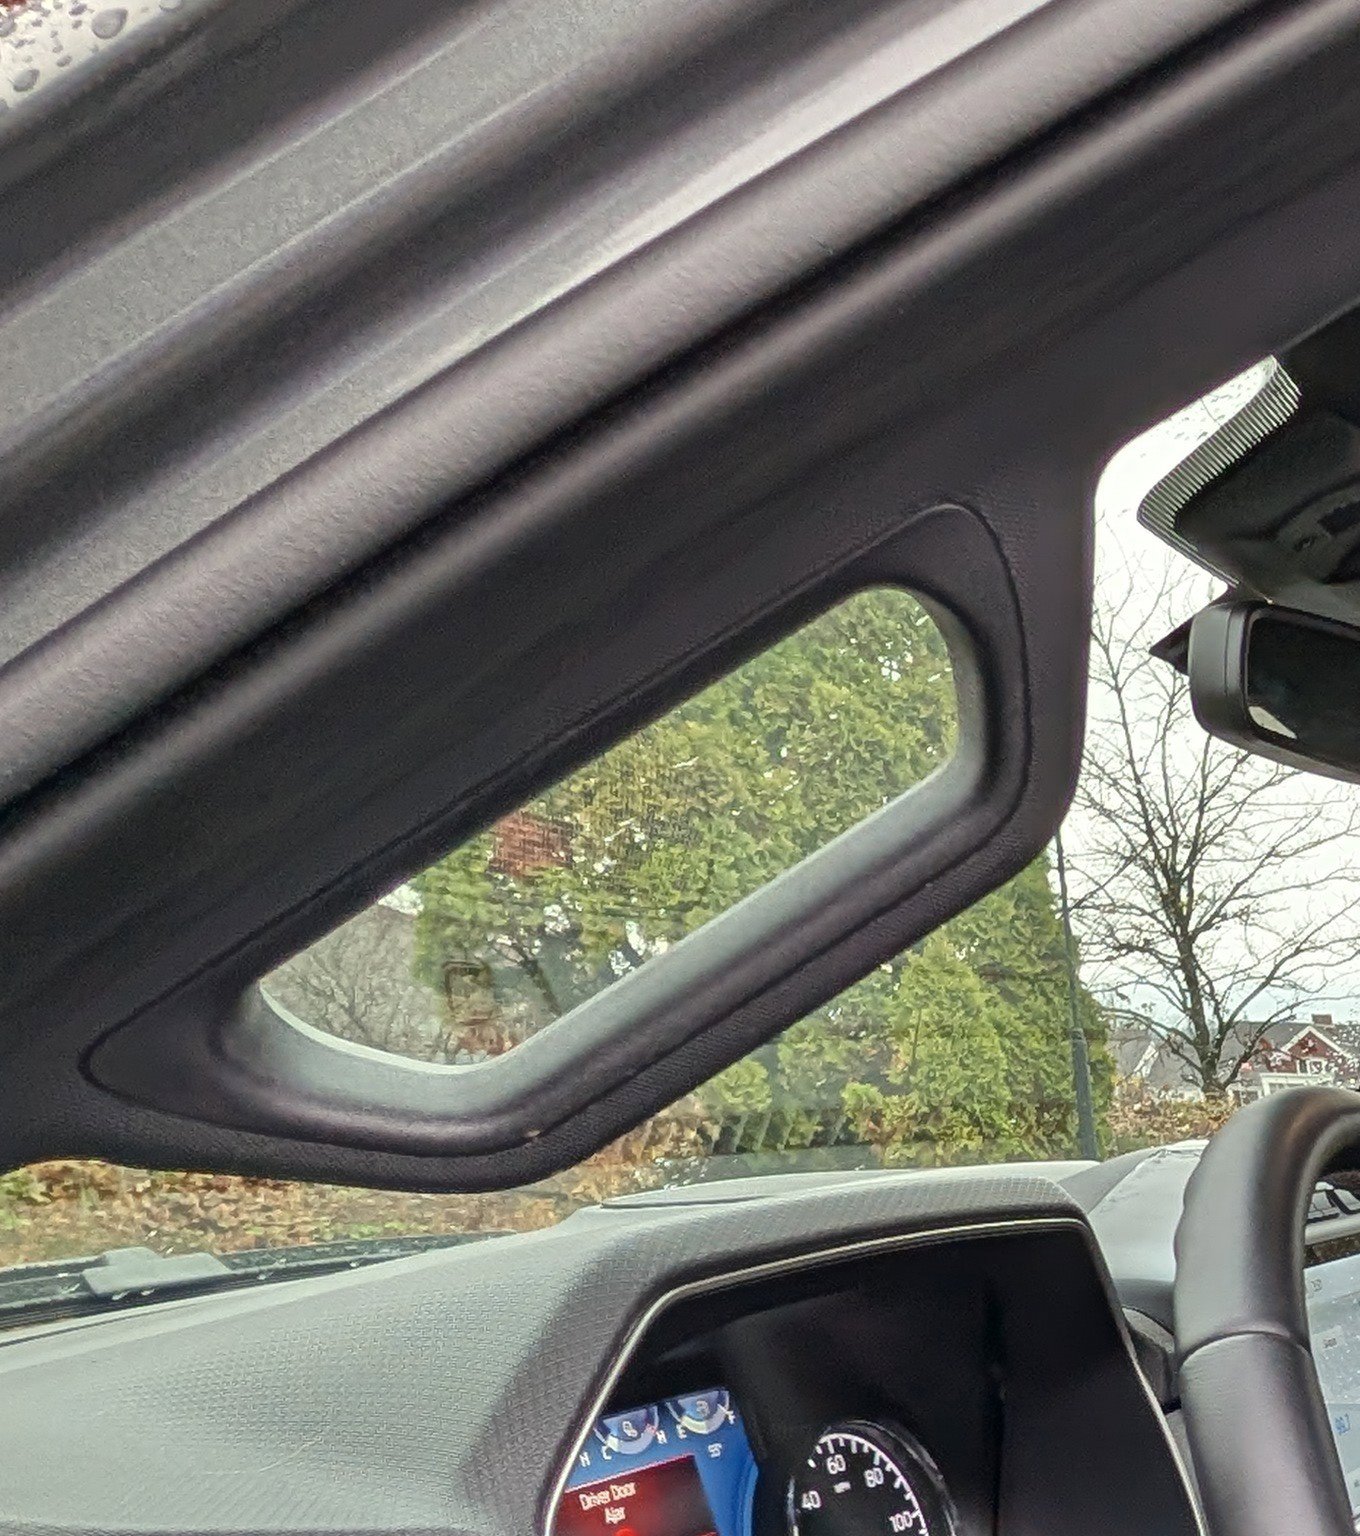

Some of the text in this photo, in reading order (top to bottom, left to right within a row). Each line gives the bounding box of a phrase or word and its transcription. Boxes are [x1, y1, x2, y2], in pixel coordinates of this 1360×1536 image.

[826, 1454, 847, 1475] 60
[864, 1466, 885, 1488] 80
[610, 1482, 637, 1501] Door
[801, 1490, 822, 1510] 40
[888, 1510, 914, 1533] 100
